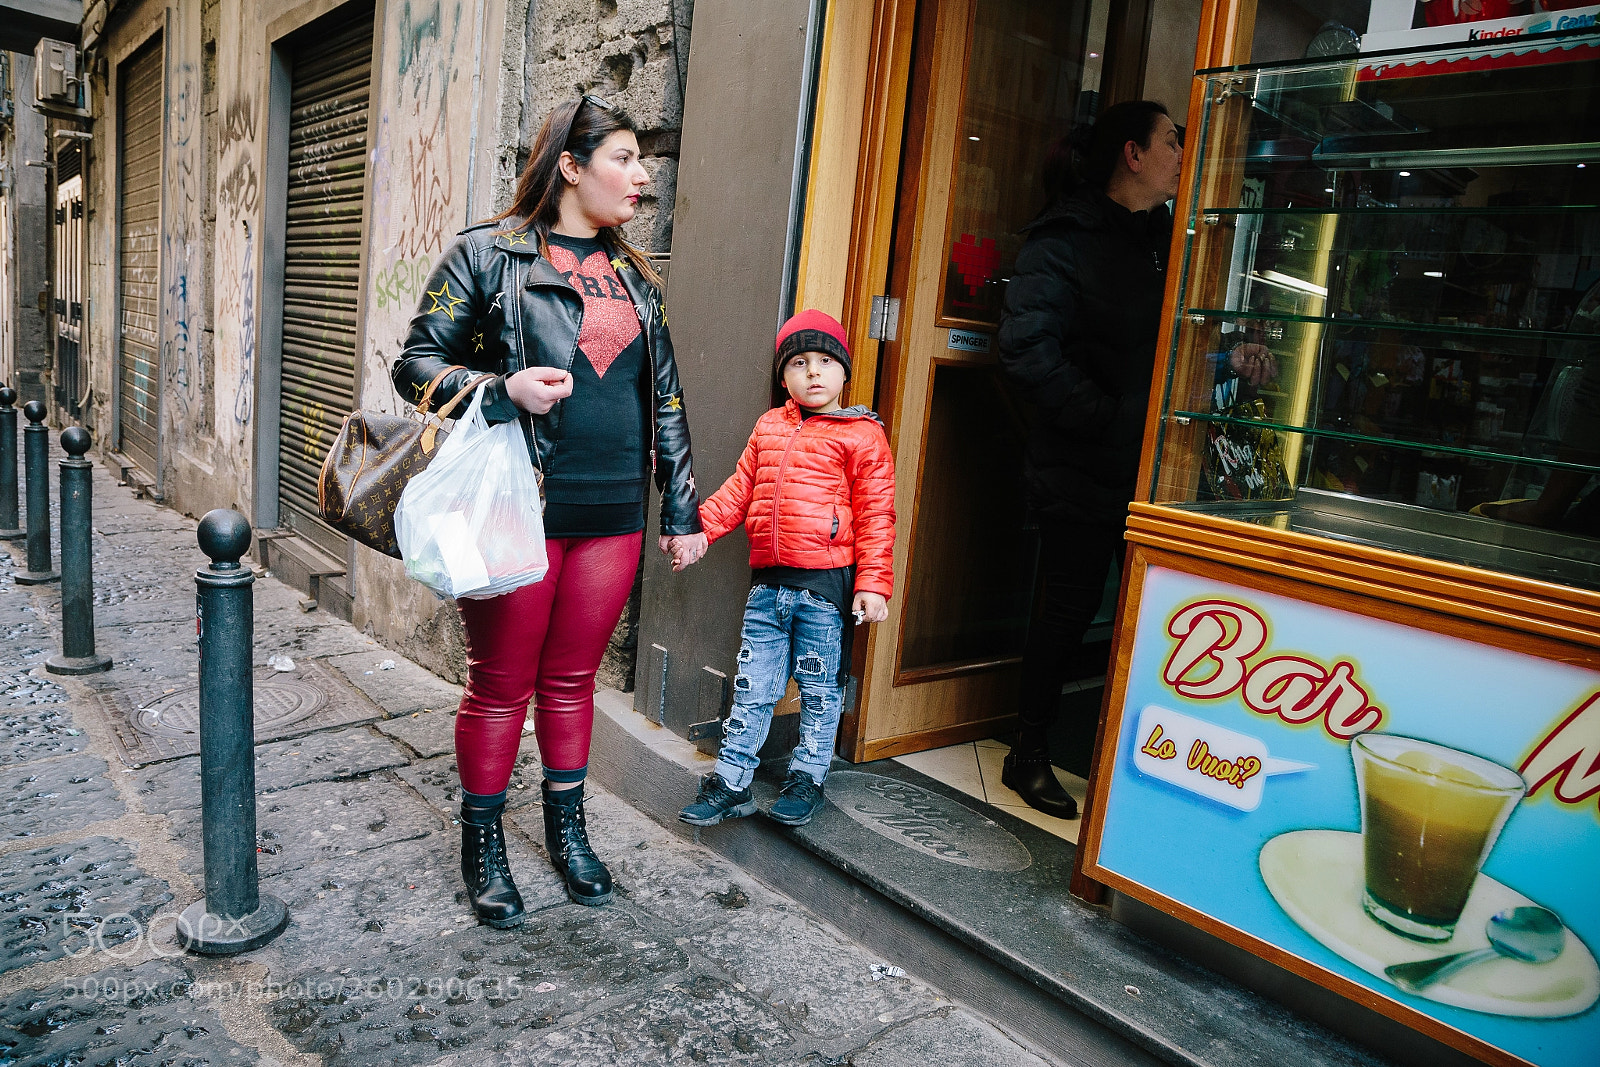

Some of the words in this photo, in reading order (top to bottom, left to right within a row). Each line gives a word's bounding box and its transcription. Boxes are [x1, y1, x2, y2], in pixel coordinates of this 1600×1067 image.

[951, 334, 988, 348] SPINGERE
[1163, 599, 1383, 740] Bar
[1141, 724, 1177, 760] Lo
[1187, 738, 1262, 790] Vuoi?
